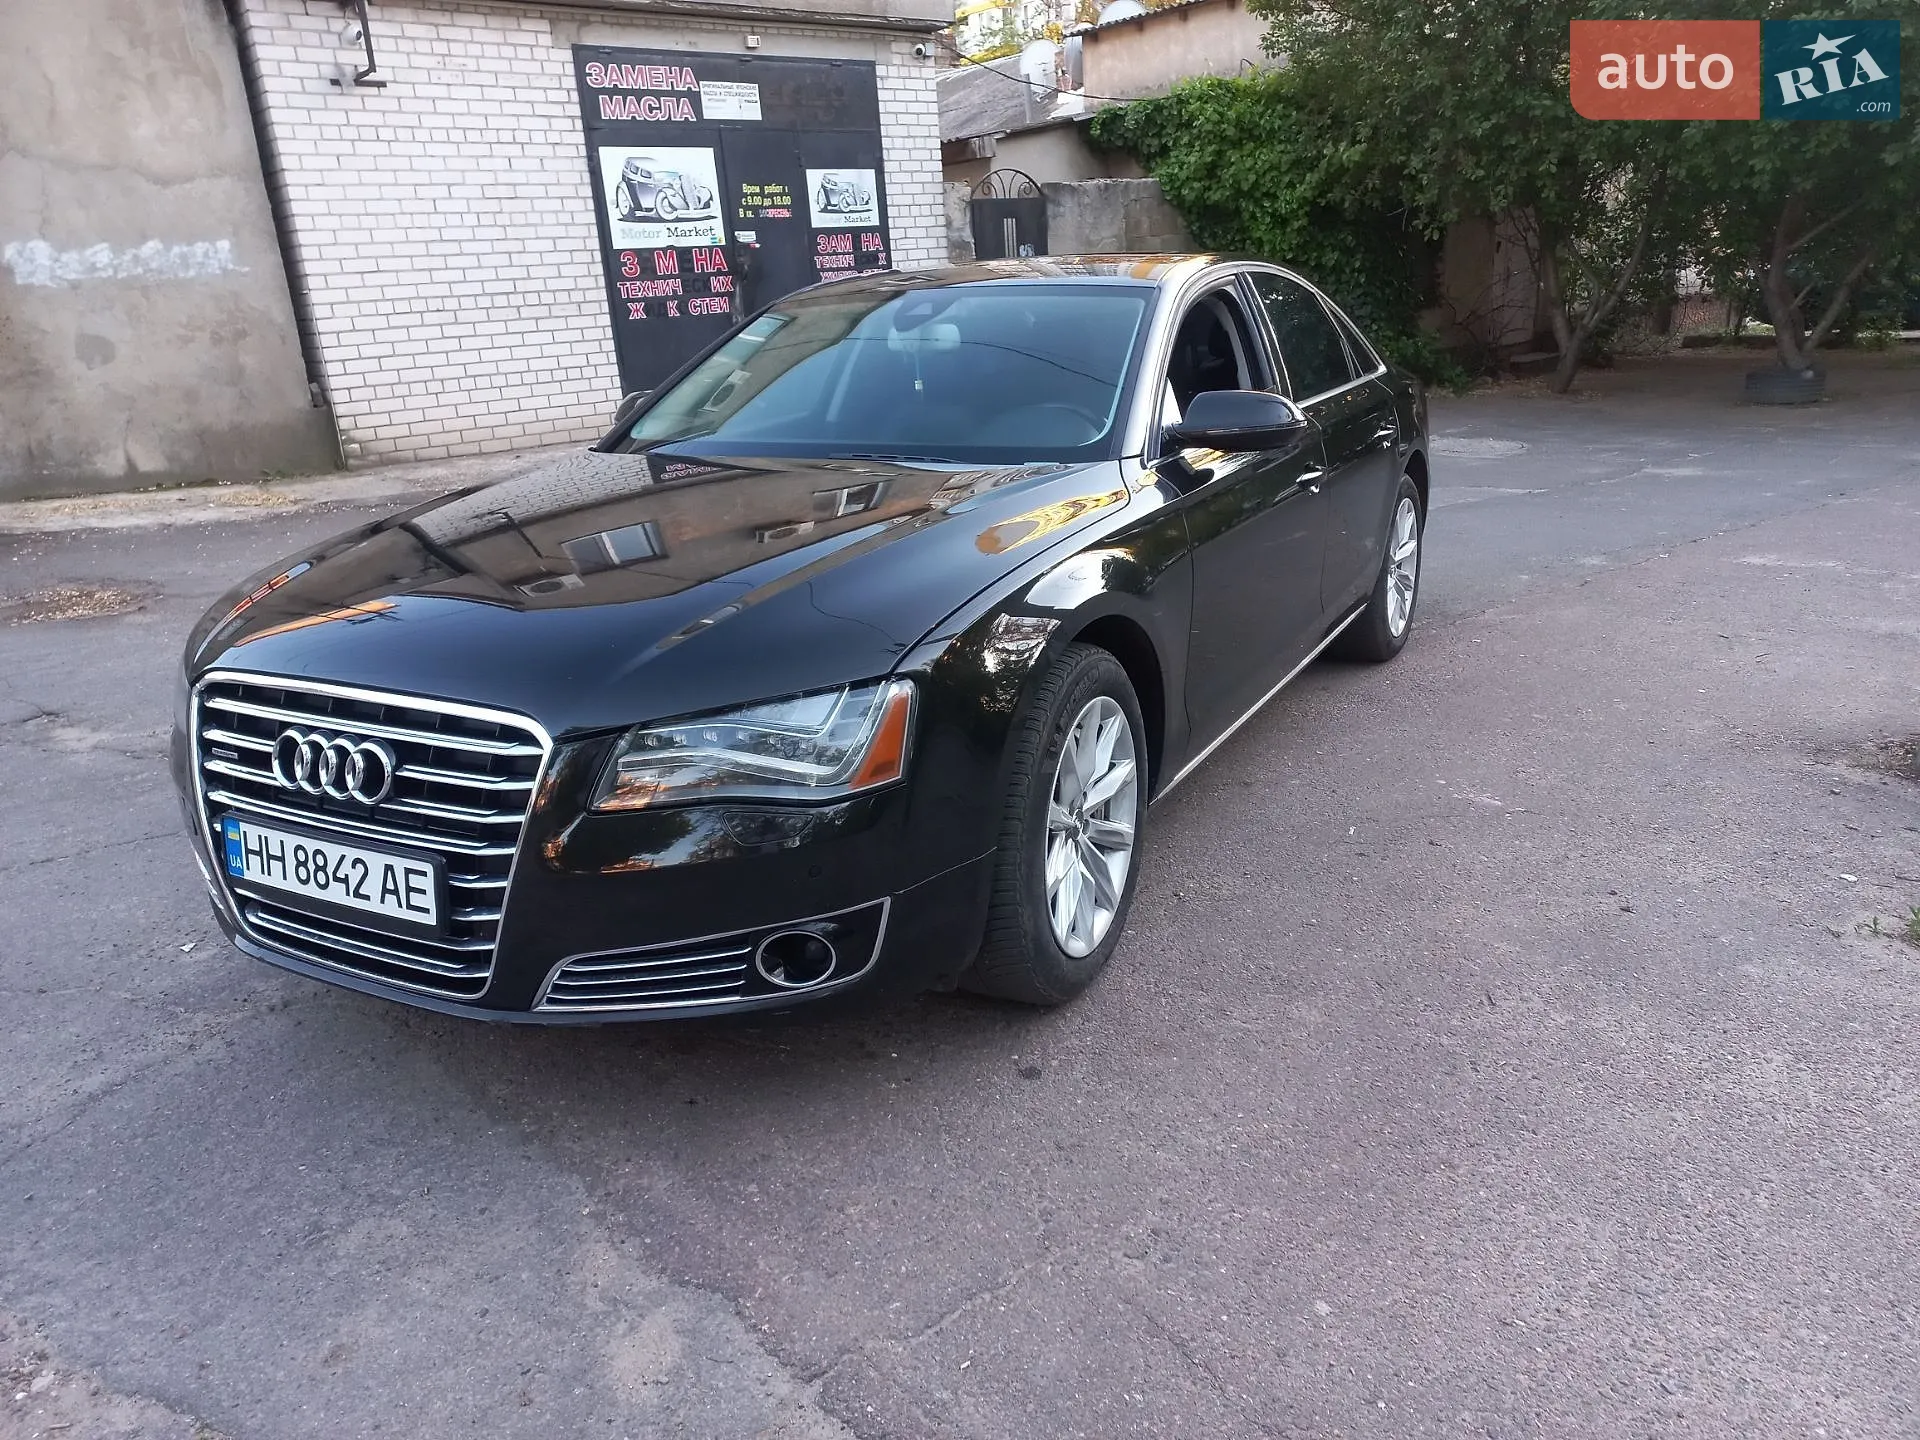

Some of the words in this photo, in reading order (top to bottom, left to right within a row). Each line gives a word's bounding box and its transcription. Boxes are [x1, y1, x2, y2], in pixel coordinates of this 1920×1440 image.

[585, 62, 700, 91] ЗАМЕНА
[599, 95, 696, 121] МАСЛА
[747, 195, 762, 205] 9.00
[763, 198, 772, 206] до
[773, 195, 792, 205] 18.00
[844, 215, 872, 223] Market
[620, 226, 662, 240] Motor
[666, 225, 717, 238] Market
[816, 232, 884, 254] ЗАМНА
[229, 854, 242, 869] UA
[243, 830, 288, 881] HH
[293, 843, 371, 902] 8842
[380, 863, 431, 915] AE
